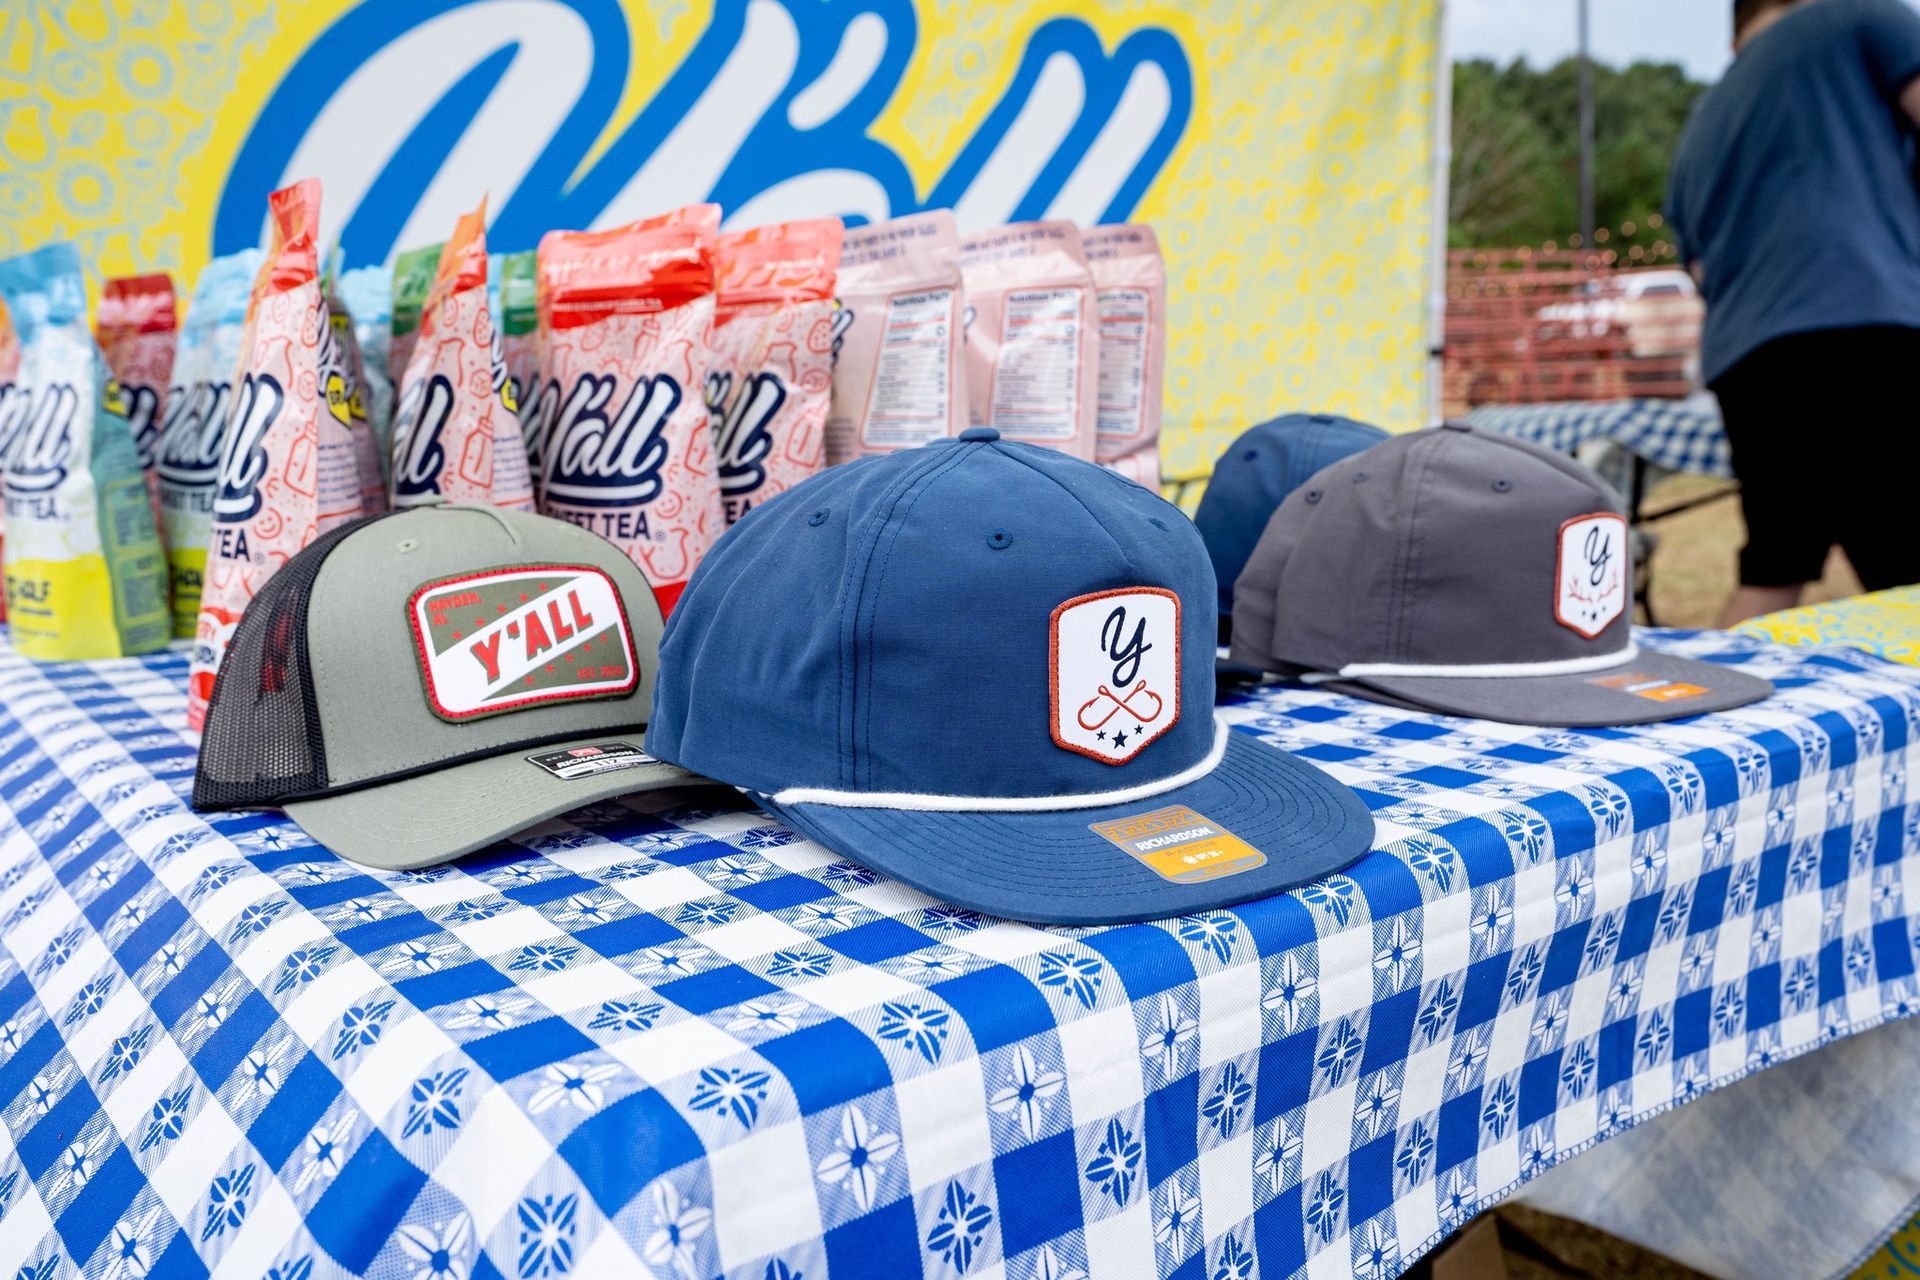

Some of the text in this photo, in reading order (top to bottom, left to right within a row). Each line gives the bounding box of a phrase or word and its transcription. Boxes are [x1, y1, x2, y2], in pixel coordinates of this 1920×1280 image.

[538, 373, 683, 508] Y'all
[602, 510, 651, 541] TEA
[469, 589, 594, 686] Y'ALL
[556, 750, 635, 769] RICHARDSON
[1135, 826, 1215, 852] RICHARDSON
